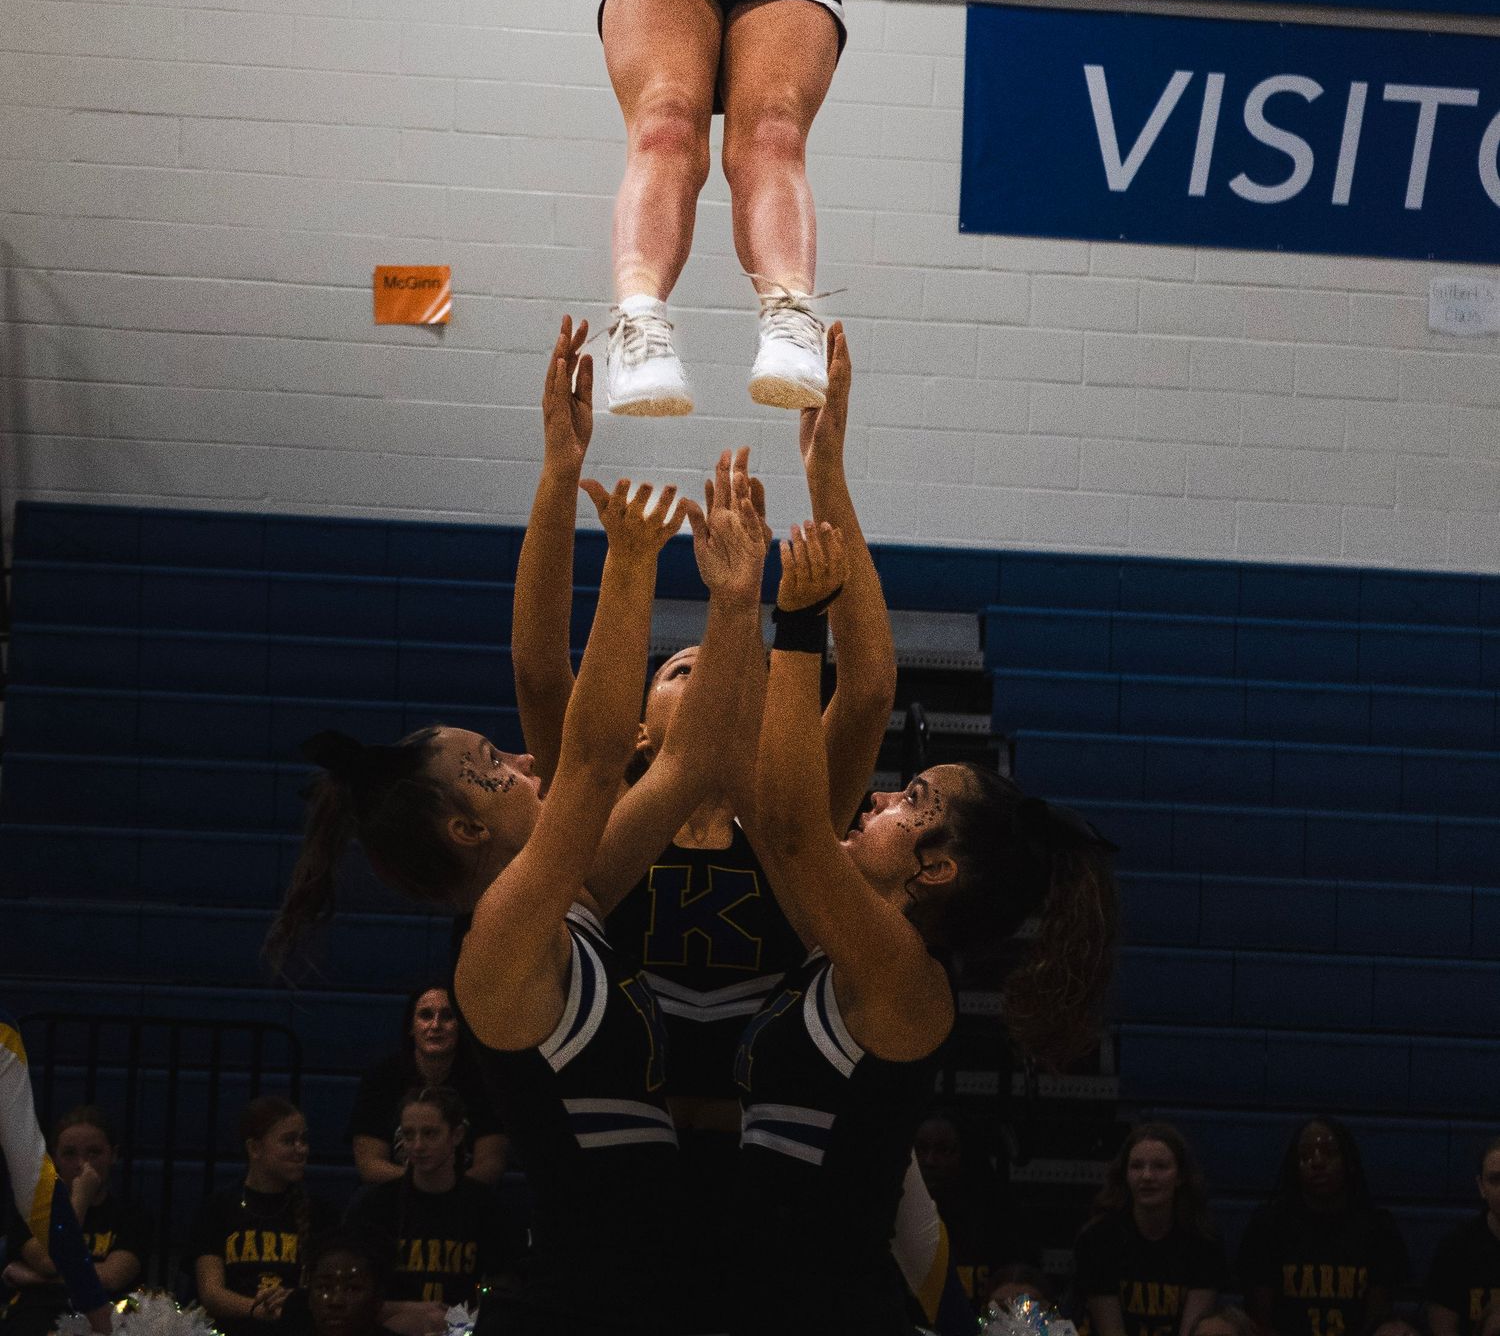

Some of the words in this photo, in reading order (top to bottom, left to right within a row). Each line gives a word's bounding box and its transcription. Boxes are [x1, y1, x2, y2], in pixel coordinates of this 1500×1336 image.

[1084, 65, 1500, 211] VISIT
[383, 276, 442, 291] McGinn
[643, 865, 762, 970] K
